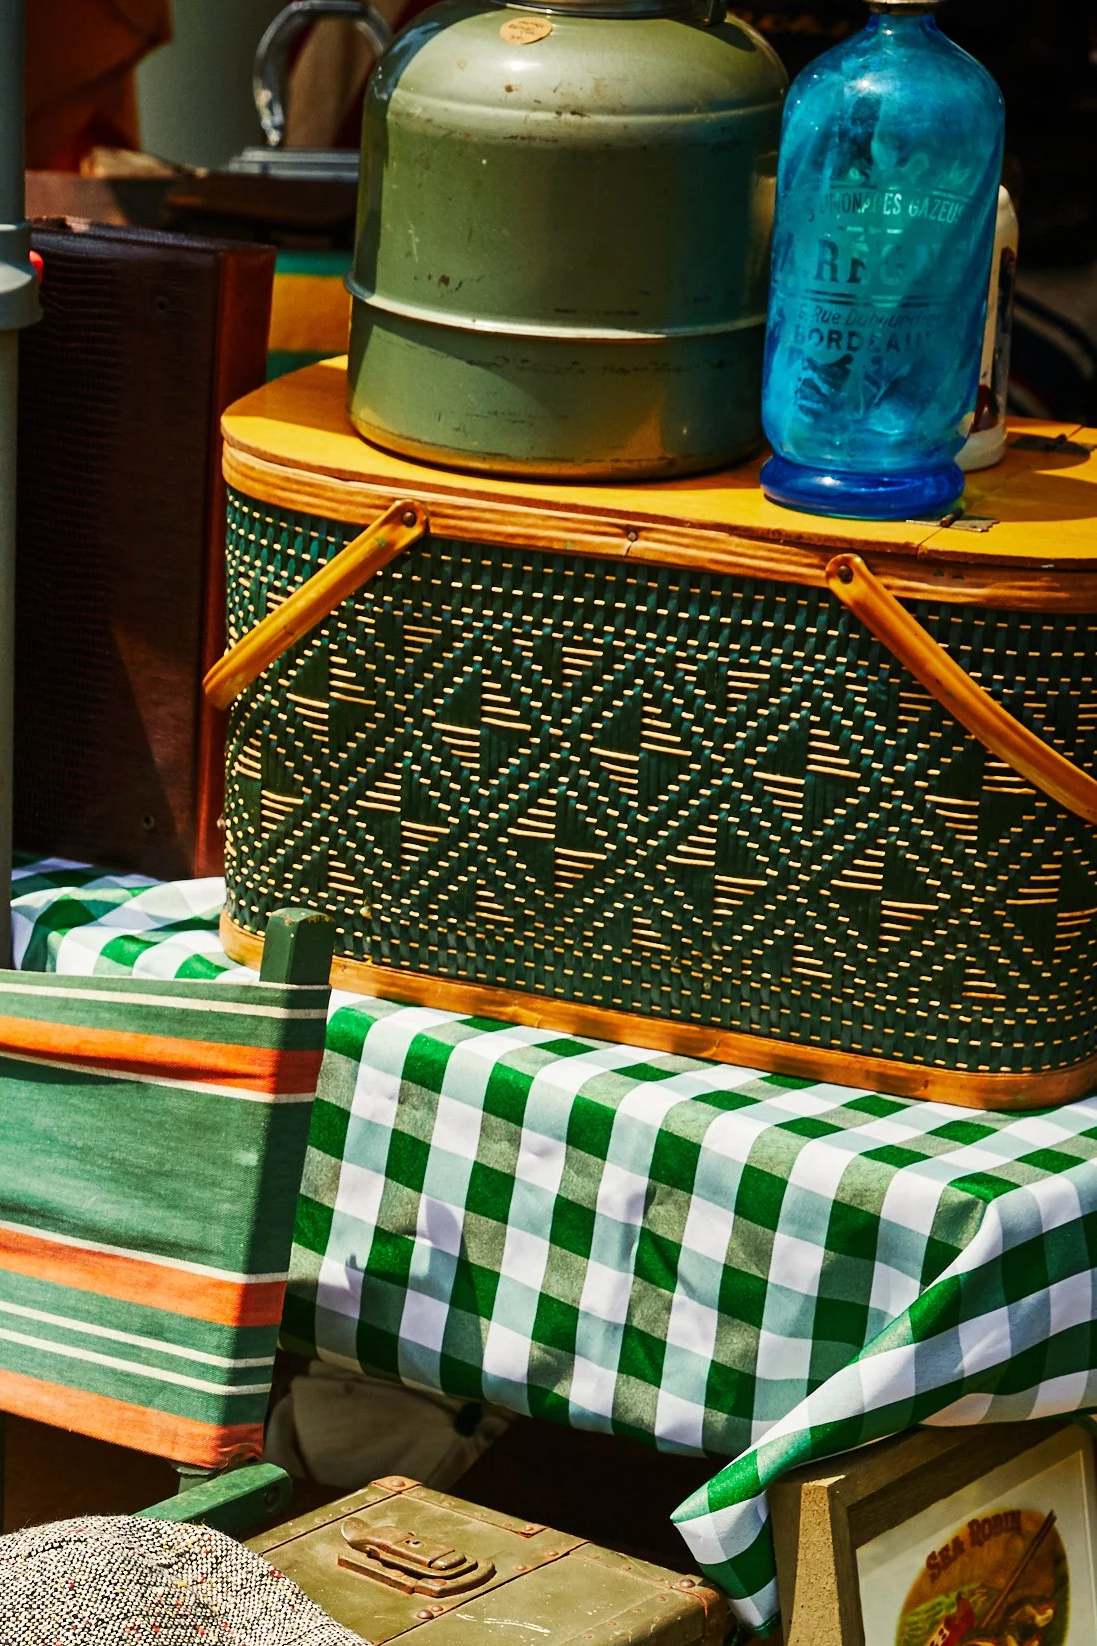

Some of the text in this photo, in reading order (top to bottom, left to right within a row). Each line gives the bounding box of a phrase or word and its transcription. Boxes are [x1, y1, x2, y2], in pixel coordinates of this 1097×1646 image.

[813, 305, 841, 326] Rue
[794, 325, 932, 353] BORDEAU
[925, 1509, 1022, 1584] SEA ROBIN
